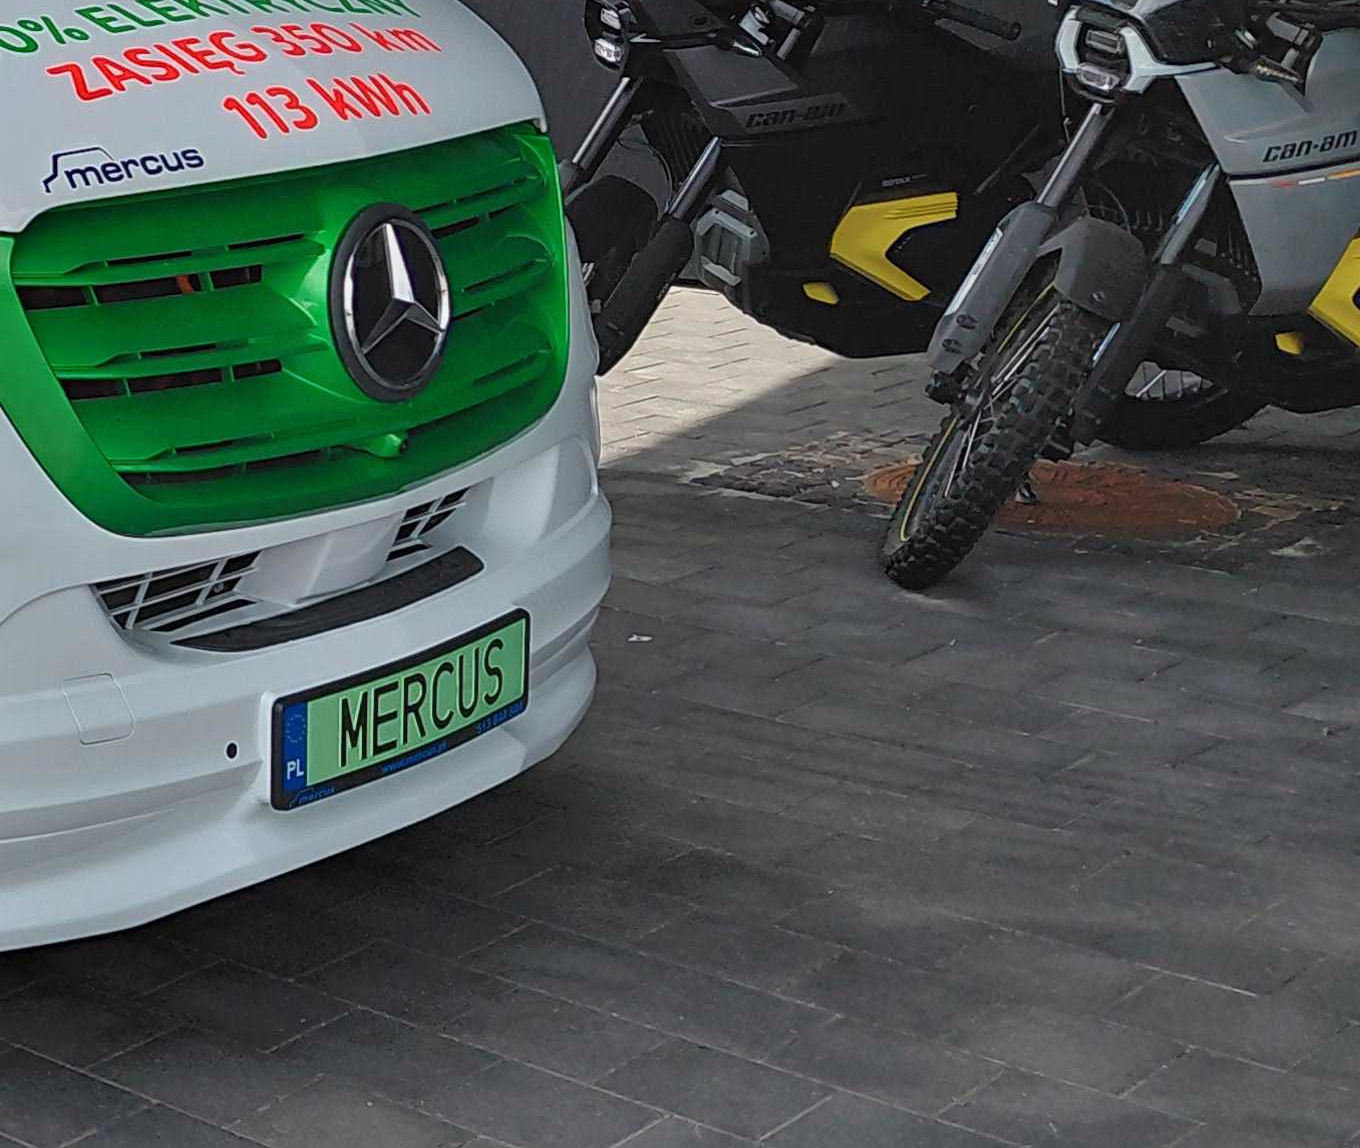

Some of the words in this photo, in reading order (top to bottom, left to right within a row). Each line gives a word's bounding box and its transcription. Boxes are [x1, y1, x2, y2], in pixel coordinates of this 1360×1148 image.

[47, 30, 267, 102] ZASIĘG
[261, 24, 353, 62] 350
[352, 21, 443, 53] km
[224, 86, 317, 139] 113
[310, 72, 432, 121] kWh
[745, 103, 845, 129] can-am
[1262, 130, 1359, 163] can-am
[64, 147, 205, 192] mercus
[339, 637, 504, 769] MERCUS
[286, 758, 305, 780] PL
